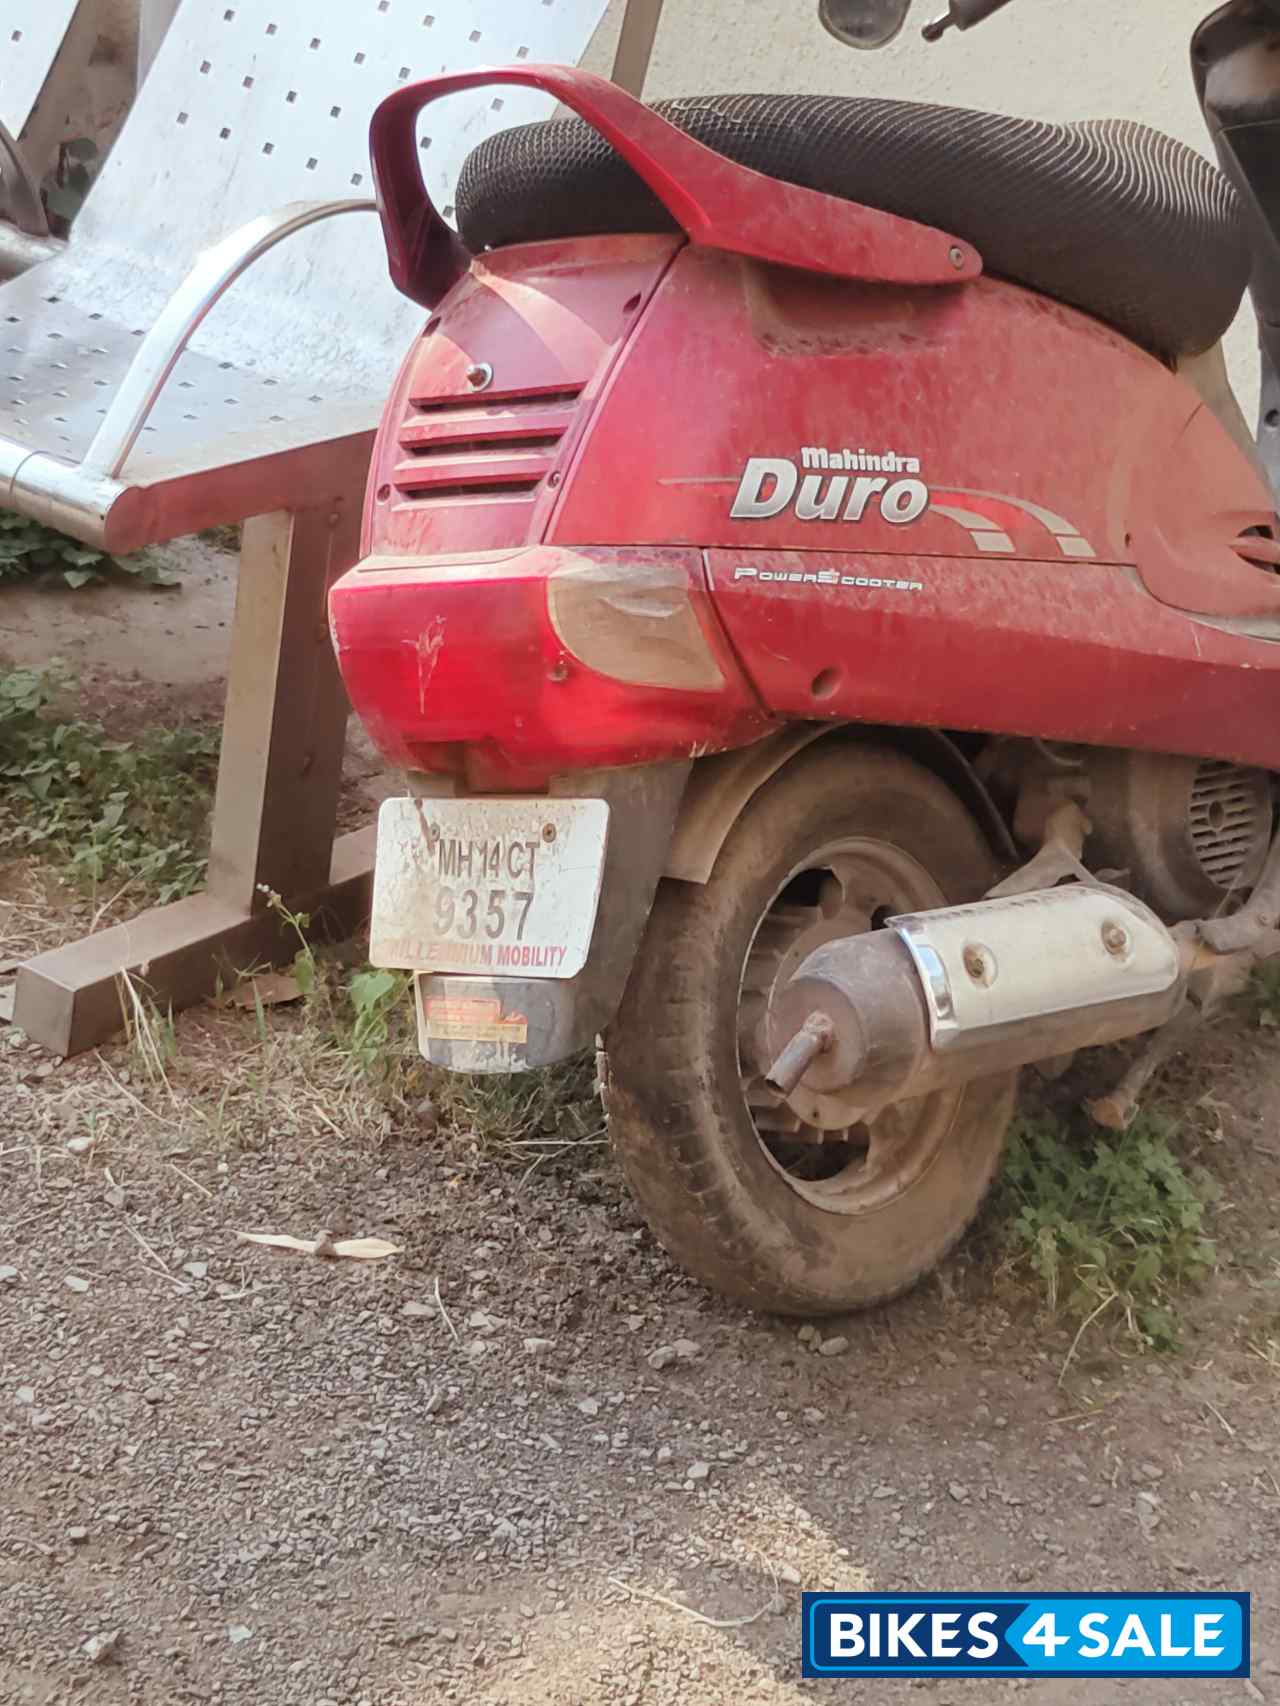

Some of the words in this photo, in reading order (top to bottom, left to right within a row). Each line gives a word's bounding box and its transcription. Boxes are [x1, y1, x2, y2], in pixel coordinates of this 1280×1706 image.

[801, 446, 920, 473] Mahindra
[730, 457, 929, 523] Duro
[433, 886, 534, 940] 9357
[496, 945, 568, 967] MOBILITY
